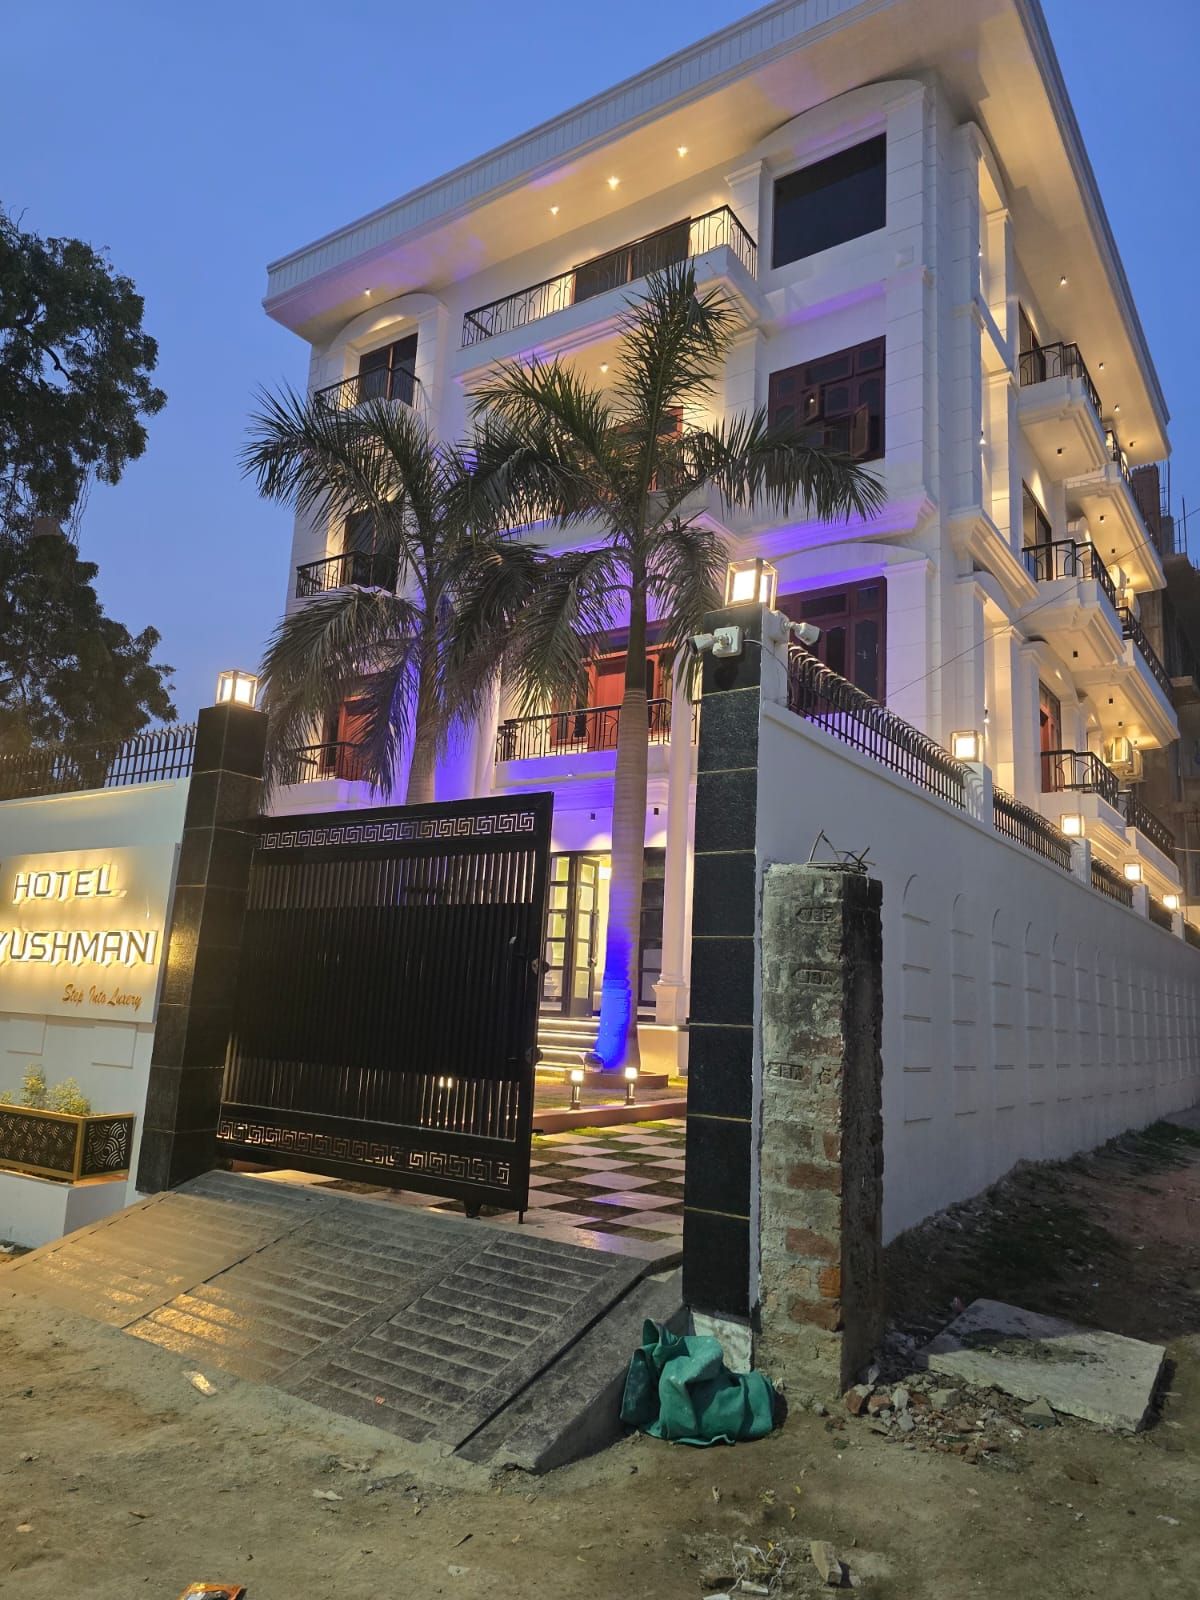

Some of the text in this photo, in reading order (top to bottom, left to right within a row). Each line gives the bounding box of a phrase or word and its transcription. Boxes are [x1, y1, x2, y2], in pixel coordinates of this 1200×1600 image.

[14, 864, 119, 902] HOTEL
[62, 983, 84, 1007] Step
[89, 985, 107, 1004] Into
